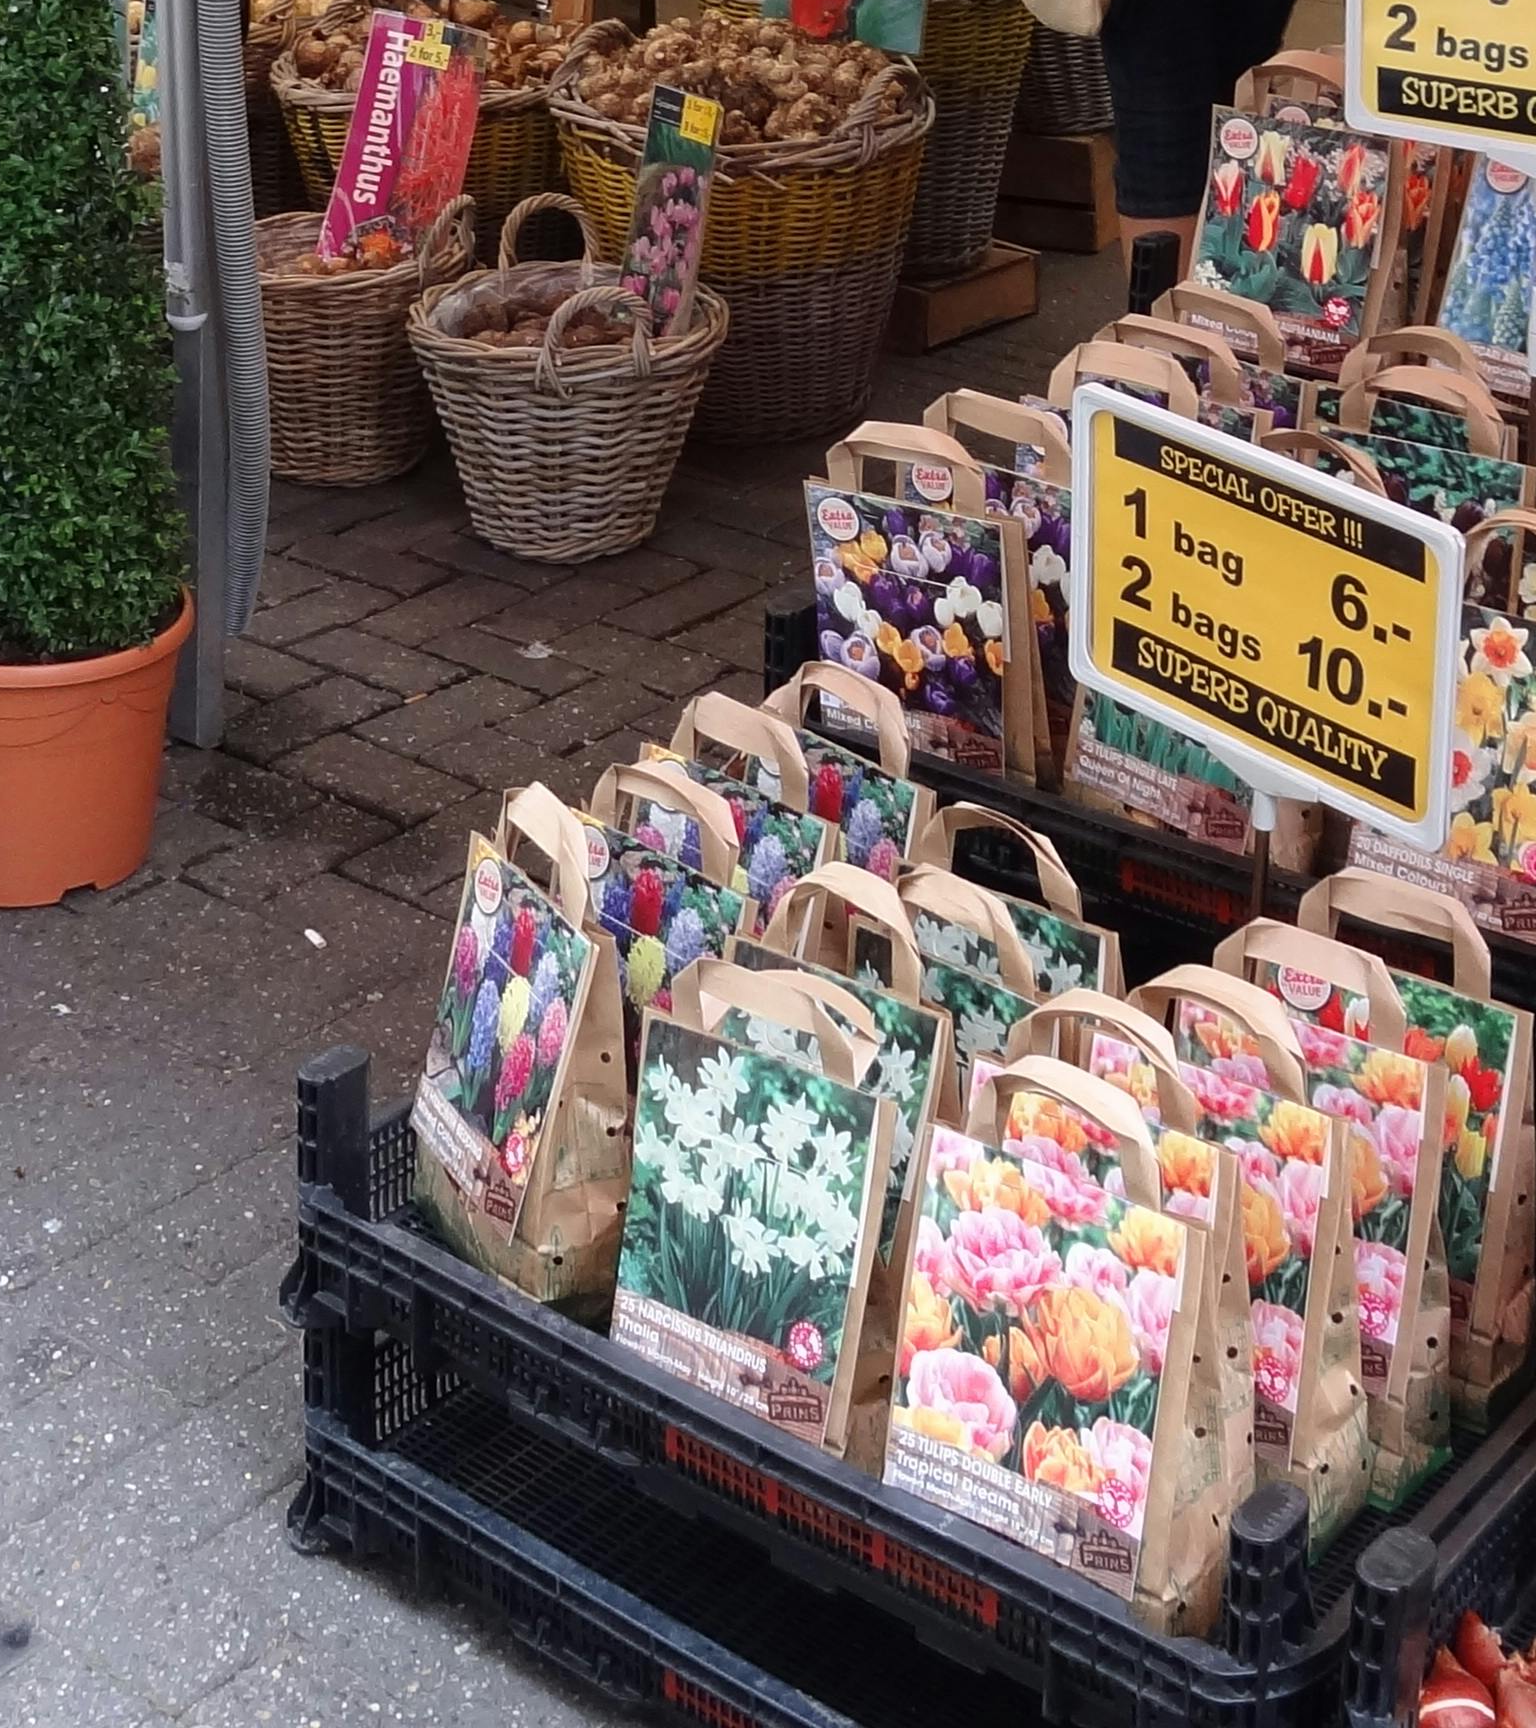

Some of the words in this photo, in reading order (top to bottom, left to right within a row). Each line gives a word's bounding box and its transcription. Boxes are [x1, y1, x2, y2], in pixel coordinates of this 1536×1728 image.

[409, 46, 417, 58] 2
[418, 47, 434, 62] for
[1384, 4, 1417, 53] 2
[1435, 27, 1529, 73] bags
[353, 29, 414, 205] Haemanthus
[1401, 77, 1518, 120] SUPERB
[916, 468, 948, 480] Extra
[1160, 445, 1254, 505] SPECIAL
[1260, 488, 1337, 539] OFFER
[822, 509, 853, 520] Extra
[828, 521, 852, 530] VALUE
[1123, 487, 1148, 540] 1
[1174, 521, 1244, 587] bag
[1330, 573, 1412, 644] 6.-
[1119, 555, 1153, 613] 2
[1171, 591, 1262, 662] bags
[1297, 635, 1408, 720] 10.-
[826, 707, 861, 727] Mixed
[1137, 637, 1249, 713] SUPERB
[1256, 696, 1388, 780] QUALITY
[1079, 756, 1115, 778] Queen
[1132, 778, 1162, 799] Night
[1081, 740, 1094, 753] 25
[1094, 743, 1124, 766] TULIPS
[1124, 753, 1157, 780] SINGLE
[1157, 771, 1177, 792] LATE
[1353, 853, 1394, 877] Mixed
[1396, 865, 1450, 894] Colours
[1356, 836, 1372, 850] 20
[1373, 840, 1432, 870] DAFFODILS
[1434, 860, 1475, 885] SINGLE
[1289, 981, 1323, 997] VALUE
[486, 1199, 514, 1221] PRINS
[617, 1312, 660, 1345] Thalia
[620, 1295, 636, 1313] 25
[637, 1303, 703, 1342] NARCISSUS
[703, 1332, 768, 1373] TRIANDRUS
[773, 1402, 820, 1422] PRINS
[895, 1449, 960, 1488] Tropical
[962, 1471, 1020, 1514] Dreams
[899, 1430, 915, 1448] 25
[916, 1434, 960, 1468] TULIPS
[962, 1456, 1012, 1489] DOUBLE
[1014, 1476, 1053, 1509] EARLY
[1084, 1552, 1130, 1572] PRINS
